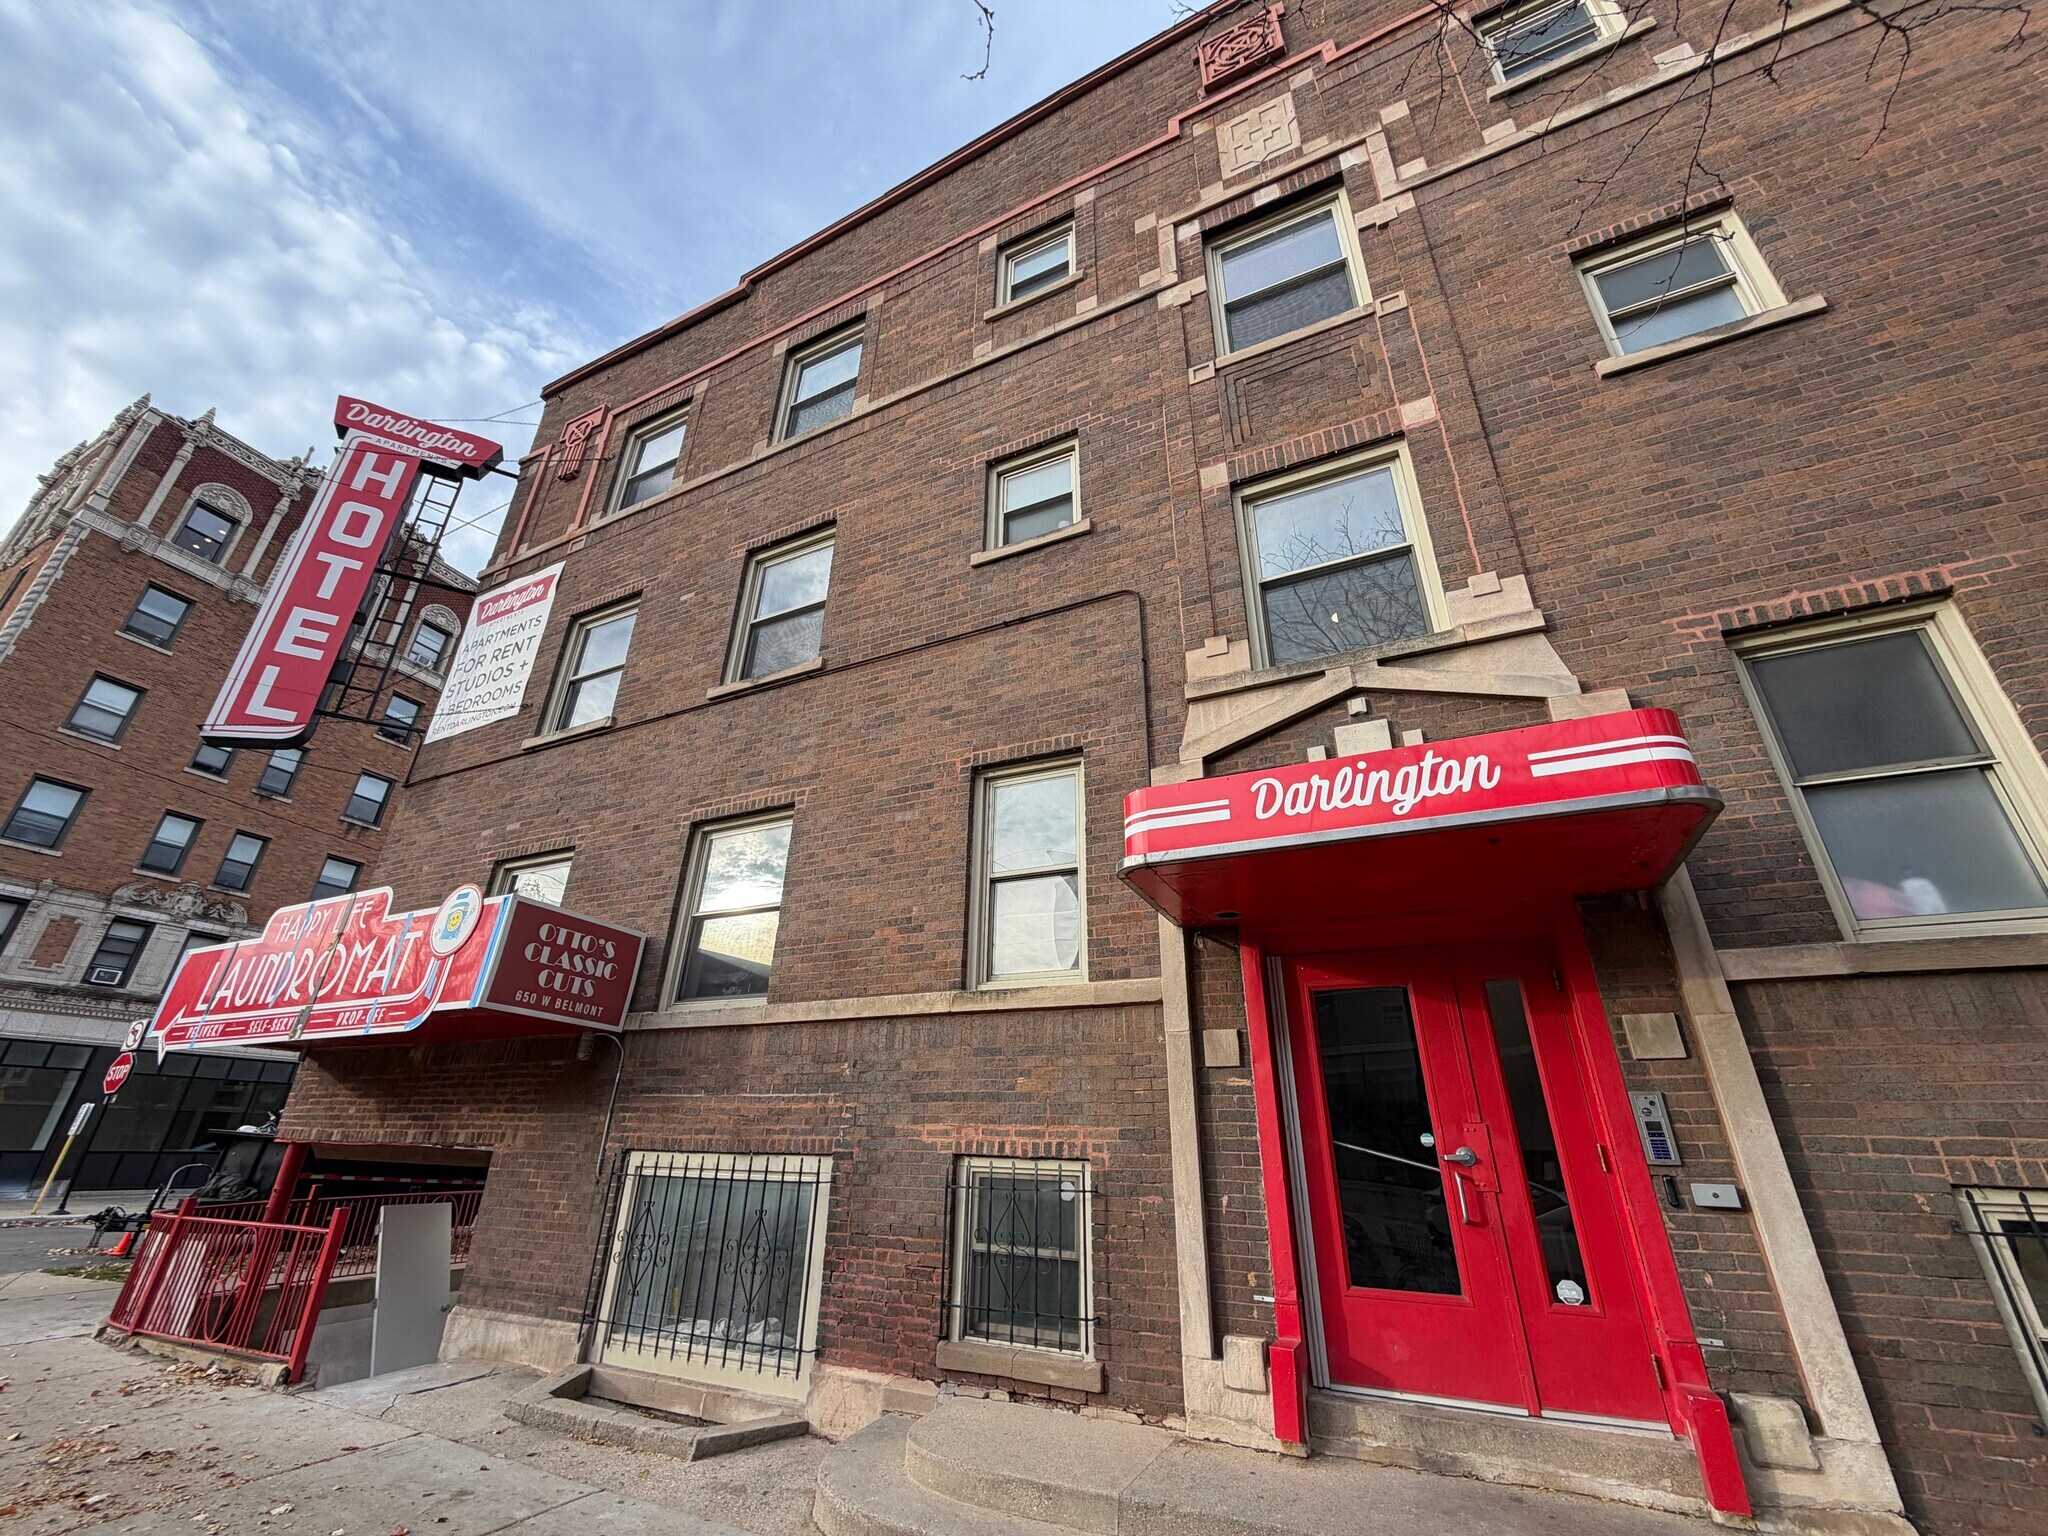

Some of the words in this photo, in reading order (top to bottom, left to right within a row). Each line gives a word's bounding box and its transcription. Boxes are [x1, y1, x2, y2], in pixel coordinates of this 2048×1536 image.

[346, 403, 478, 457] Darlington
[375, 438, 449, 464] APARTMENTS
[245, 452, 408, 723] HOTEL
[480, 583, 545, 620] Darlington
[462, 615, 543, 656] APARTMENTS
[453, 653, 487, 678] FOR
[489, 634, 537, 665] RENT
[445, 662, 515, 699] STUDIOS
[519, 659, 529, 671] +
[446, 680, 523, 716] BEDROOMS
[1250, 748, 1501, 820] Darlington
[275, 909, 333, 943] HAPPY
[332, 900, 374, 933] LFE
[539, 923, 617, 959] OTTO'S
[194, 930, 423, 1012] LAUNDROMAT
[524, 942, 619, 981] CLASSIC
[538, 969, 596, 998] CUTS
[515, 990, 537, 1004] 650
[541, 994, 551, 1007] W
[554, 998, 604, 1017] BELMONT
[247, 1016, 304, 1034] SELF-SERVI
[106, 1064, 130, 1082] STOP
